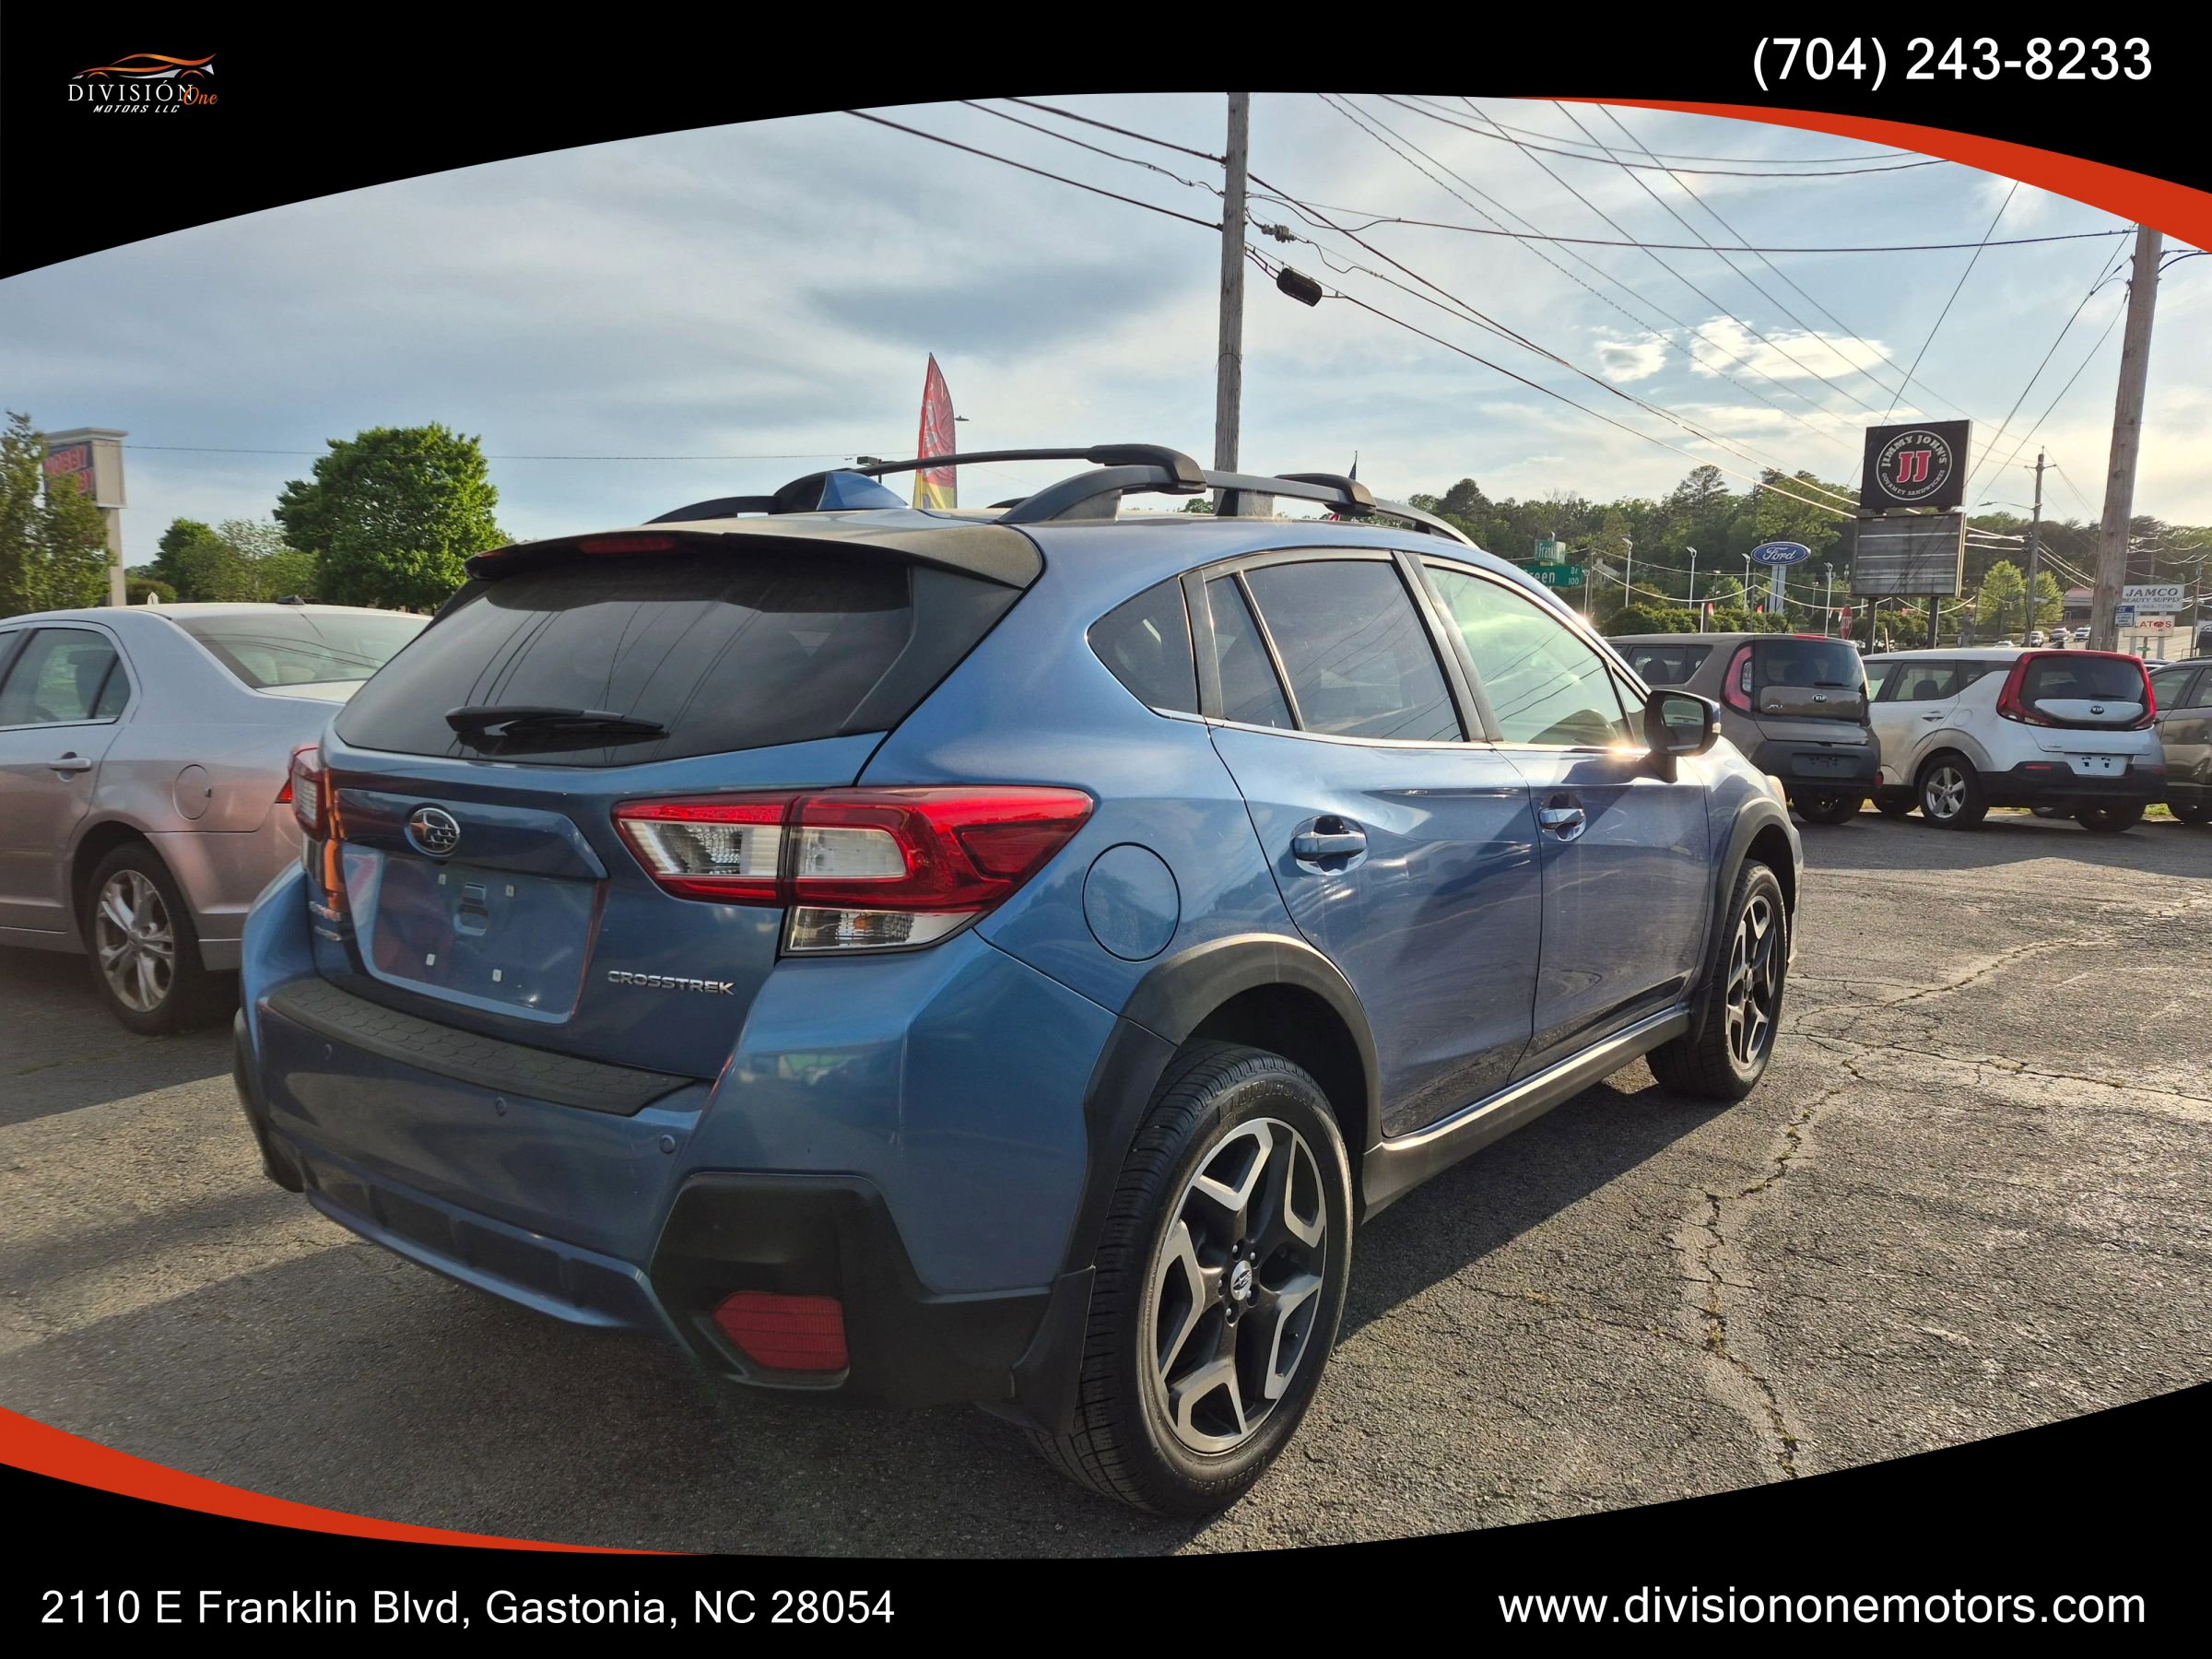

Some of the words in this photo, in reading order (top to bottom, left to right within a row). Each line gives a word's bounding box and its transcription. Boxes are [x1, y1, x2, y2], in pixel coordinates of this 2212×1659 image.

[1881, 435, 1913, 467] JIMMY
[1917, 434, 1947, 465] JOHN'S
[1896, 450, 1932, 483] JJ
[1882, 472, 1906, 495] GOURMET
[1908, 469, 1946, 496] SANDWICHES
[1762, 547, 1797, 560] Ford
[1568, 577, 1580, 585] 100
[2125, 587, 2179, 597] JAMCO
[1841, 616, 1853, 629] STOP
[607, 970, 735, 996] CROSSTREK
